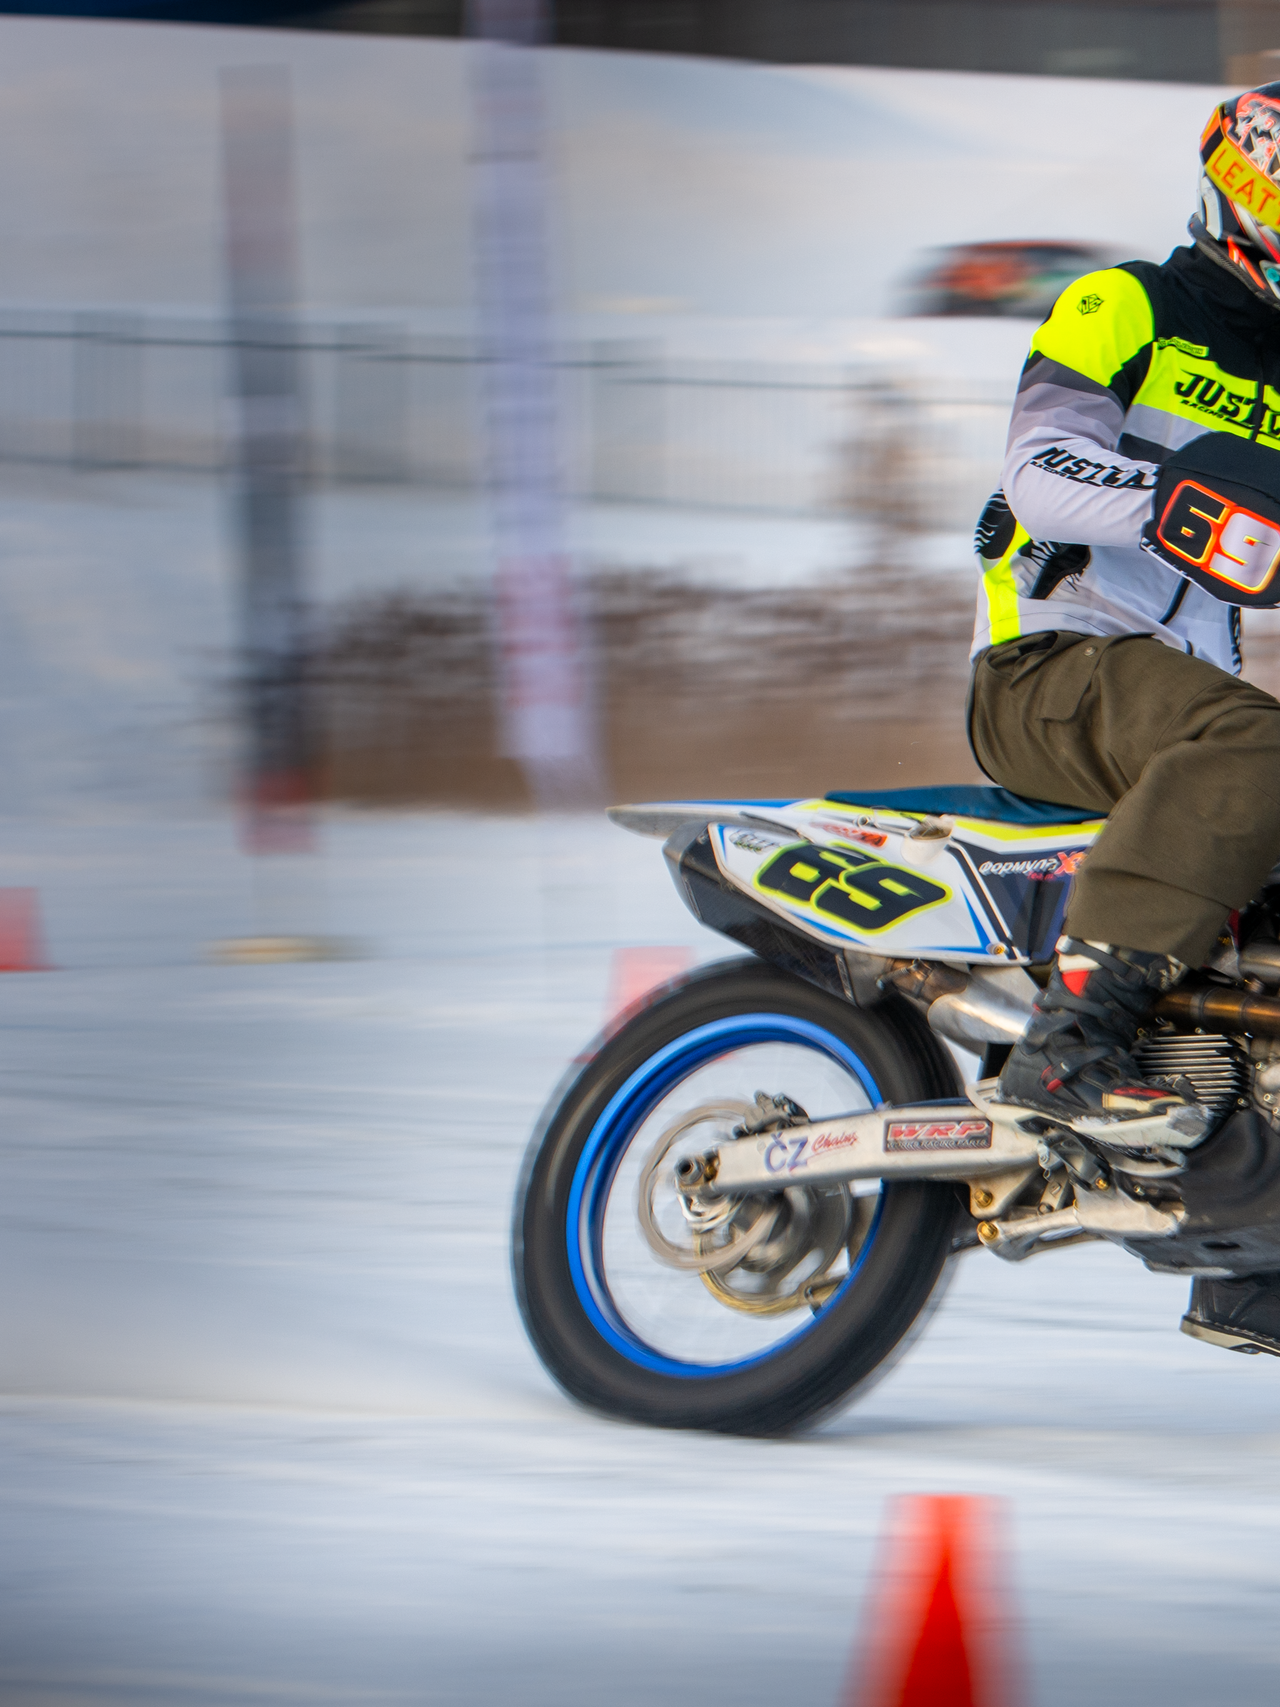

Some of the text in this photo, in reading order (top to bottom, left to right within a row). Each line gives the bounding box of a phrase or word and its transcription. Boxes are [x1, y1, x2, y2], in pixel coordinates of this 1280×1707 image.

[1179, 398, 1226, 420] RACING
[752, 840, 954, 936] 69
[887, 1120, 988, 1141] WRP
[763, 1130, 859, 1173] ČZ Chains
[926, 1139, 957, 1149] RACING
